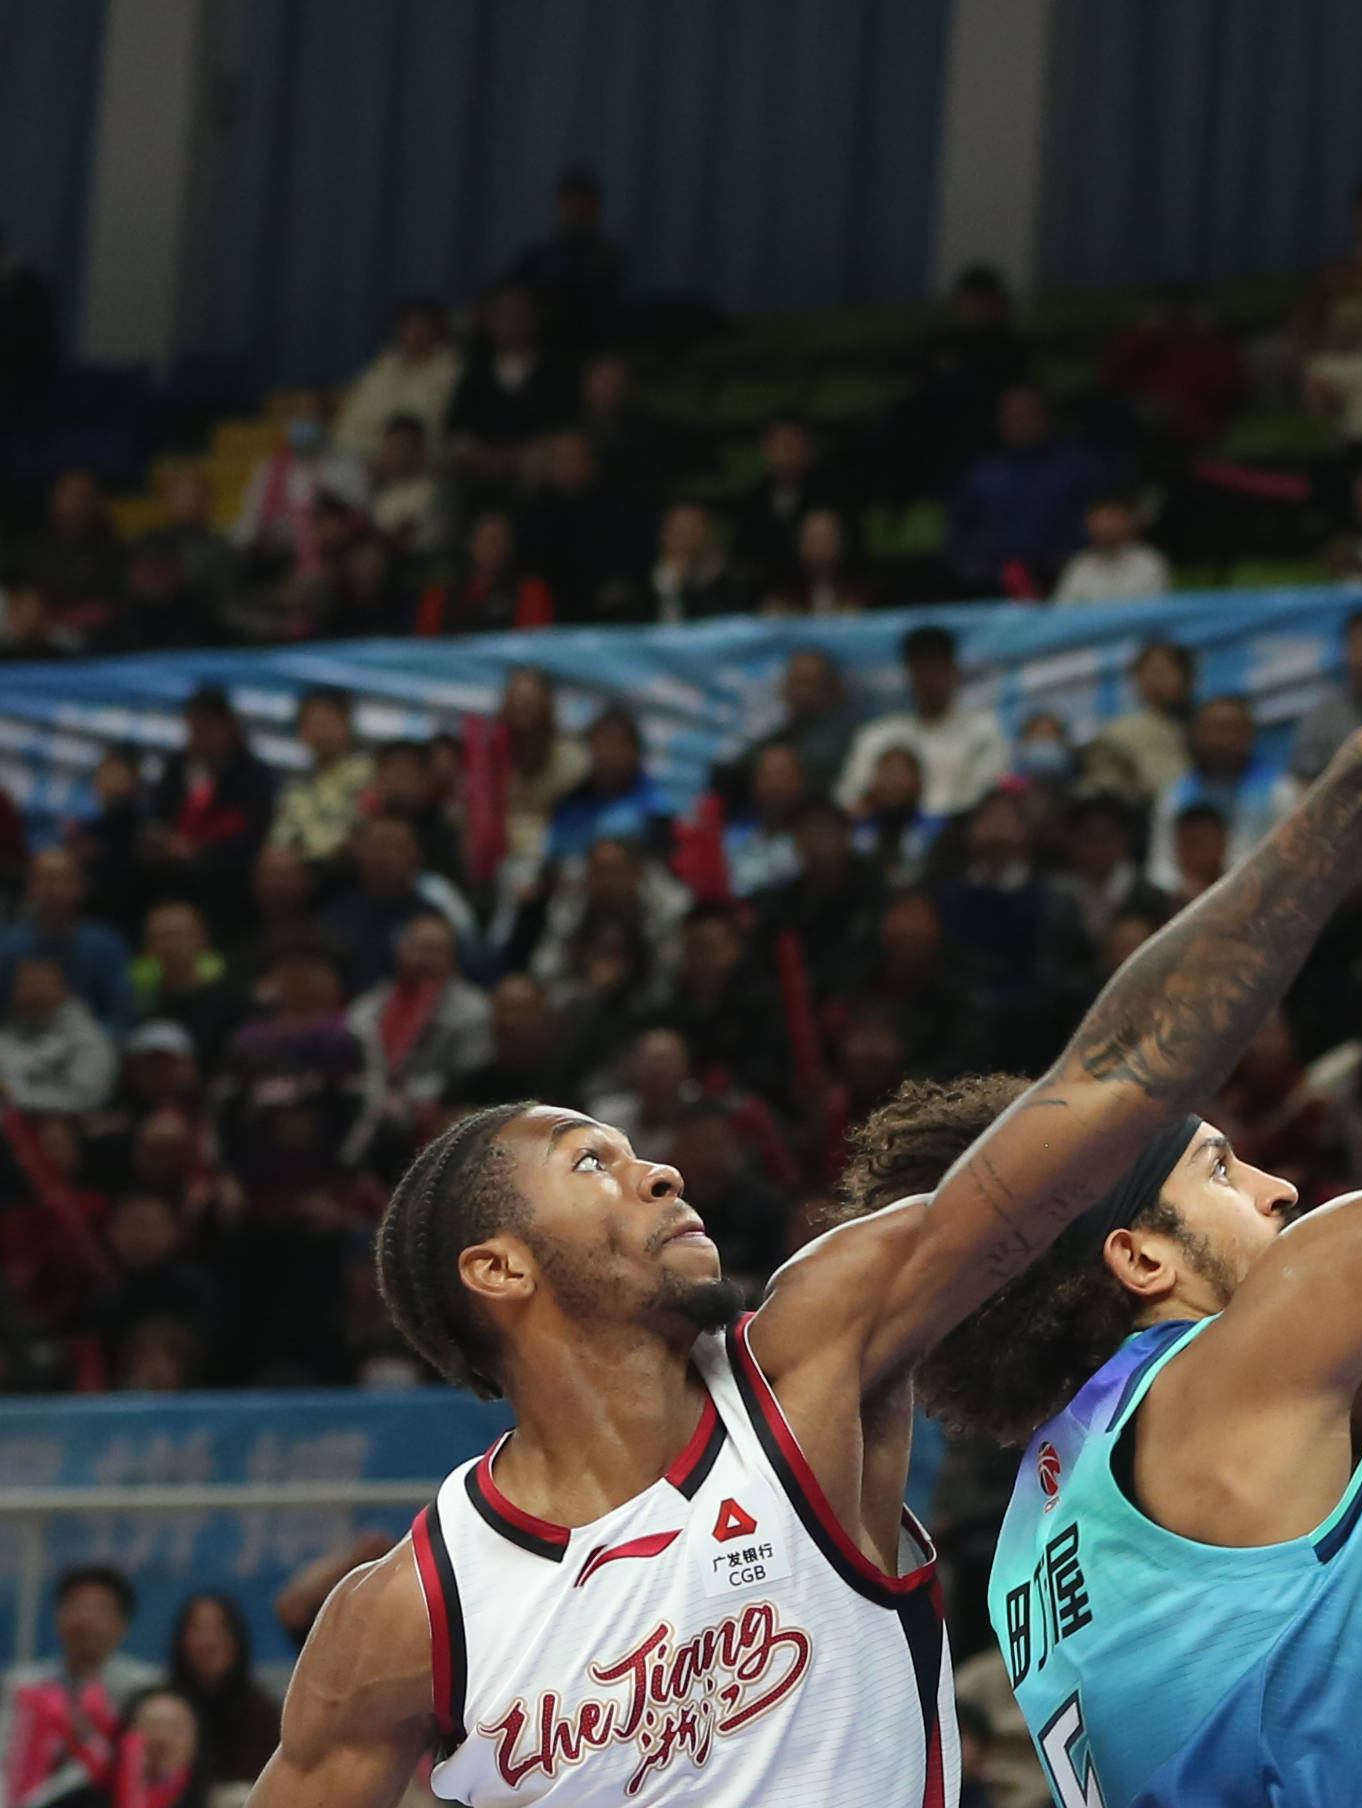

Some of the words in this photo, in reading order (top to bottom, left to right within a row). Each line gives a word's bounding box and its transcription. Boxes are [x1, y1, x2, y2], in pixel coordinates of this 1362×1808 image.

[712, 1542, 774, 1573] 广发银行
[728, 1564, 767, 1587] CGB
